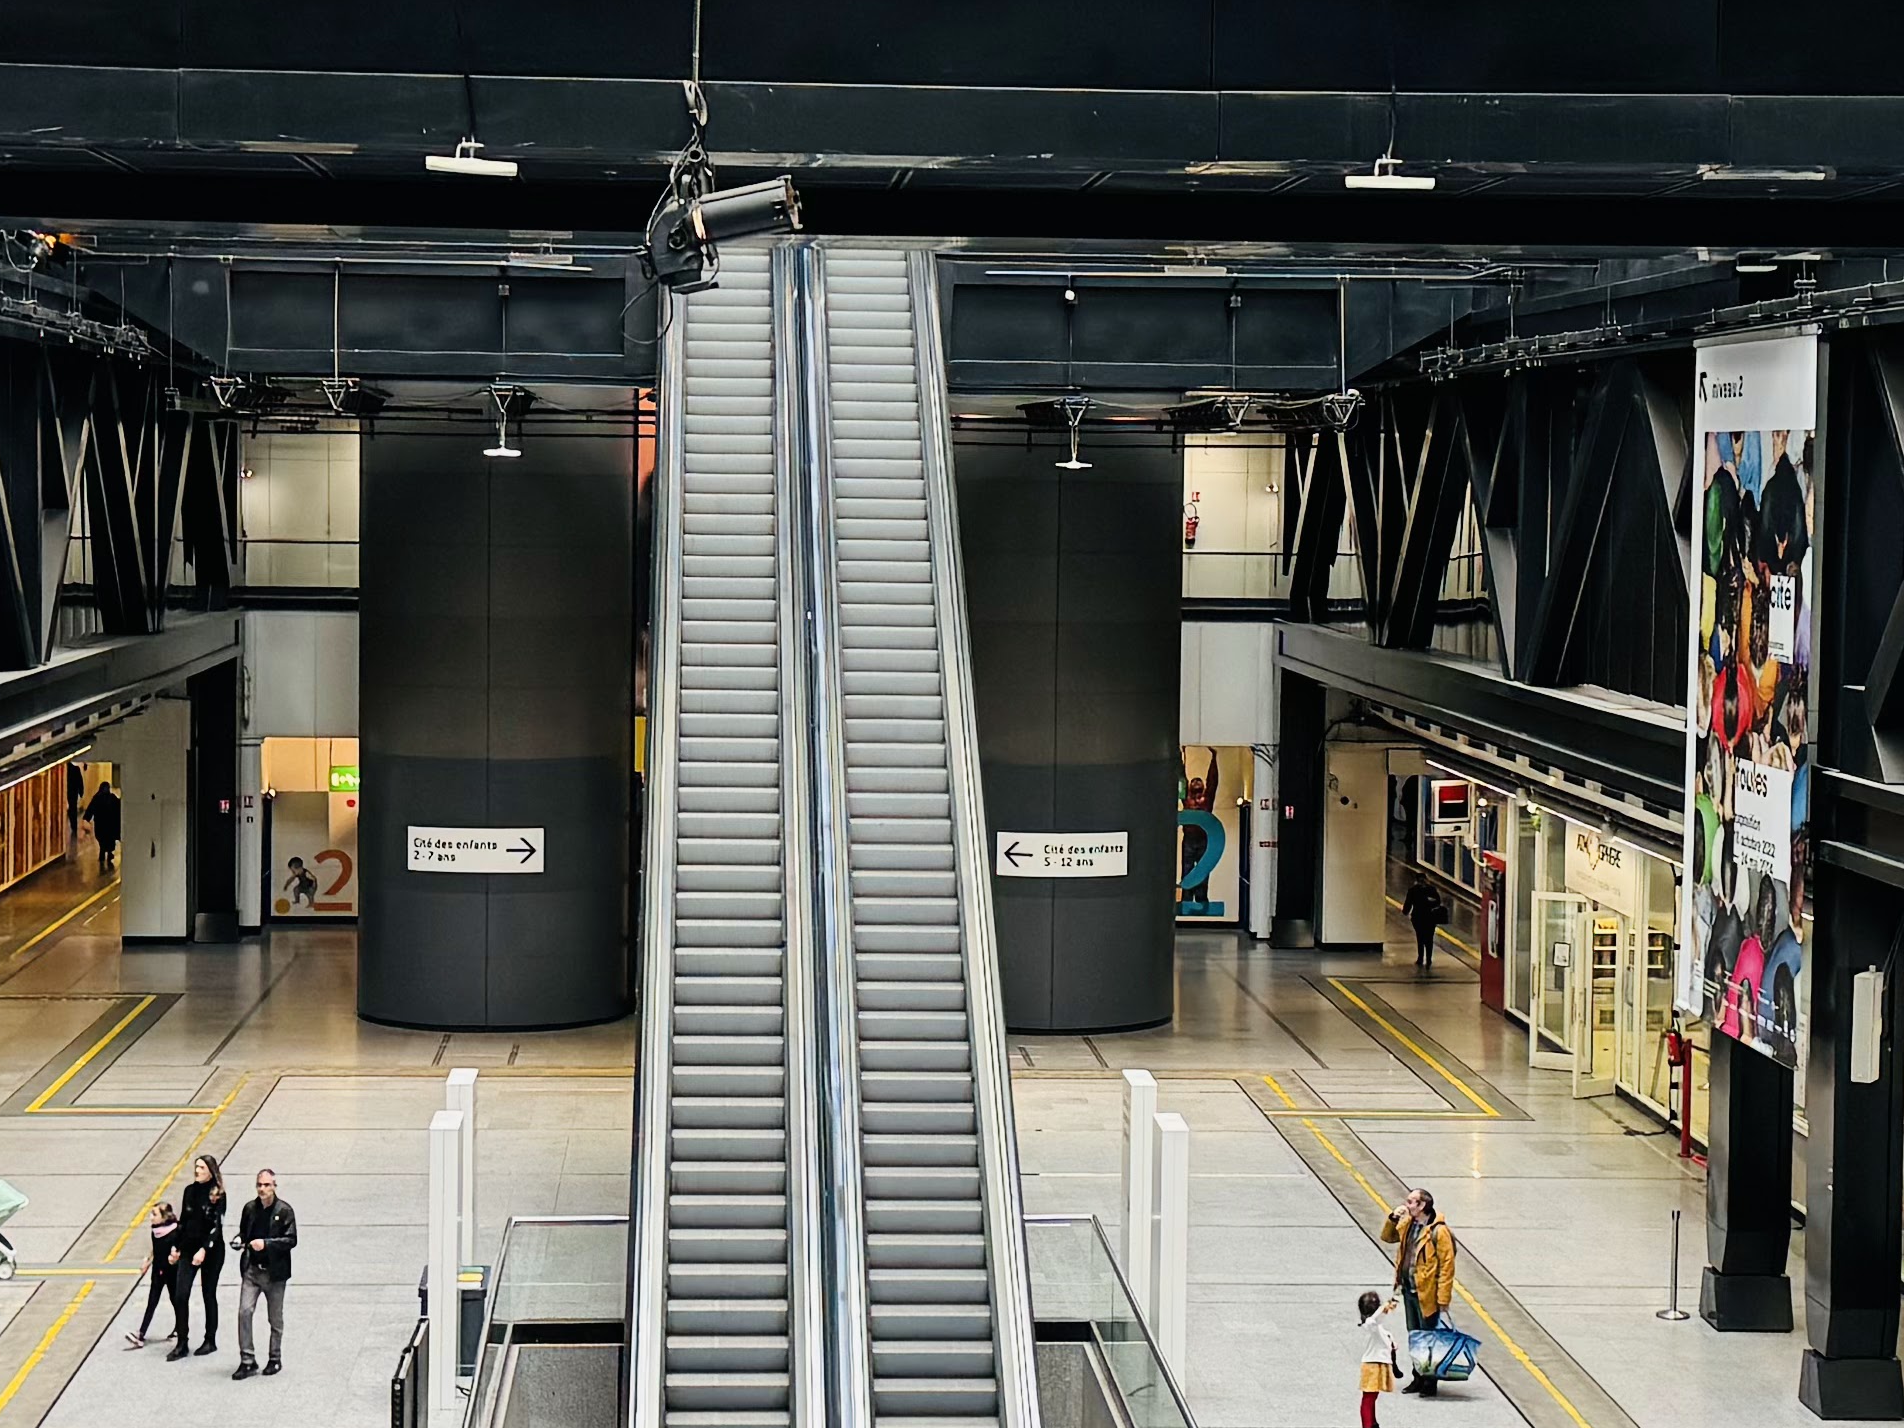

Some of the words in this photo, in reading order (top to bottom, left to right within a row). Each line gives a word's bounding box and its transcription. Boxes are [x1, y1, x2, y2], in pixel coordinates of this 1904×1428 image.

[1769, 574, 1792, 612] cité
[413, 837, 433, 850] Cité
[434, 838, 453, 850] des
[455, 837, 498, 850] enfants
[1043, 844, 1064, 855] Cité
[1067, 844, 1086, 855] des
[1088, 844, 1124, 854] enfants
[413, 850, 420, 861] 2
[427, 850, 434, 861] 7
[437, 852, 456, 862] ans
[1061, 857, 1073, 867] 12
[1075, 857, 1094, 867] ans
[313, 849, 353, 912] 2
